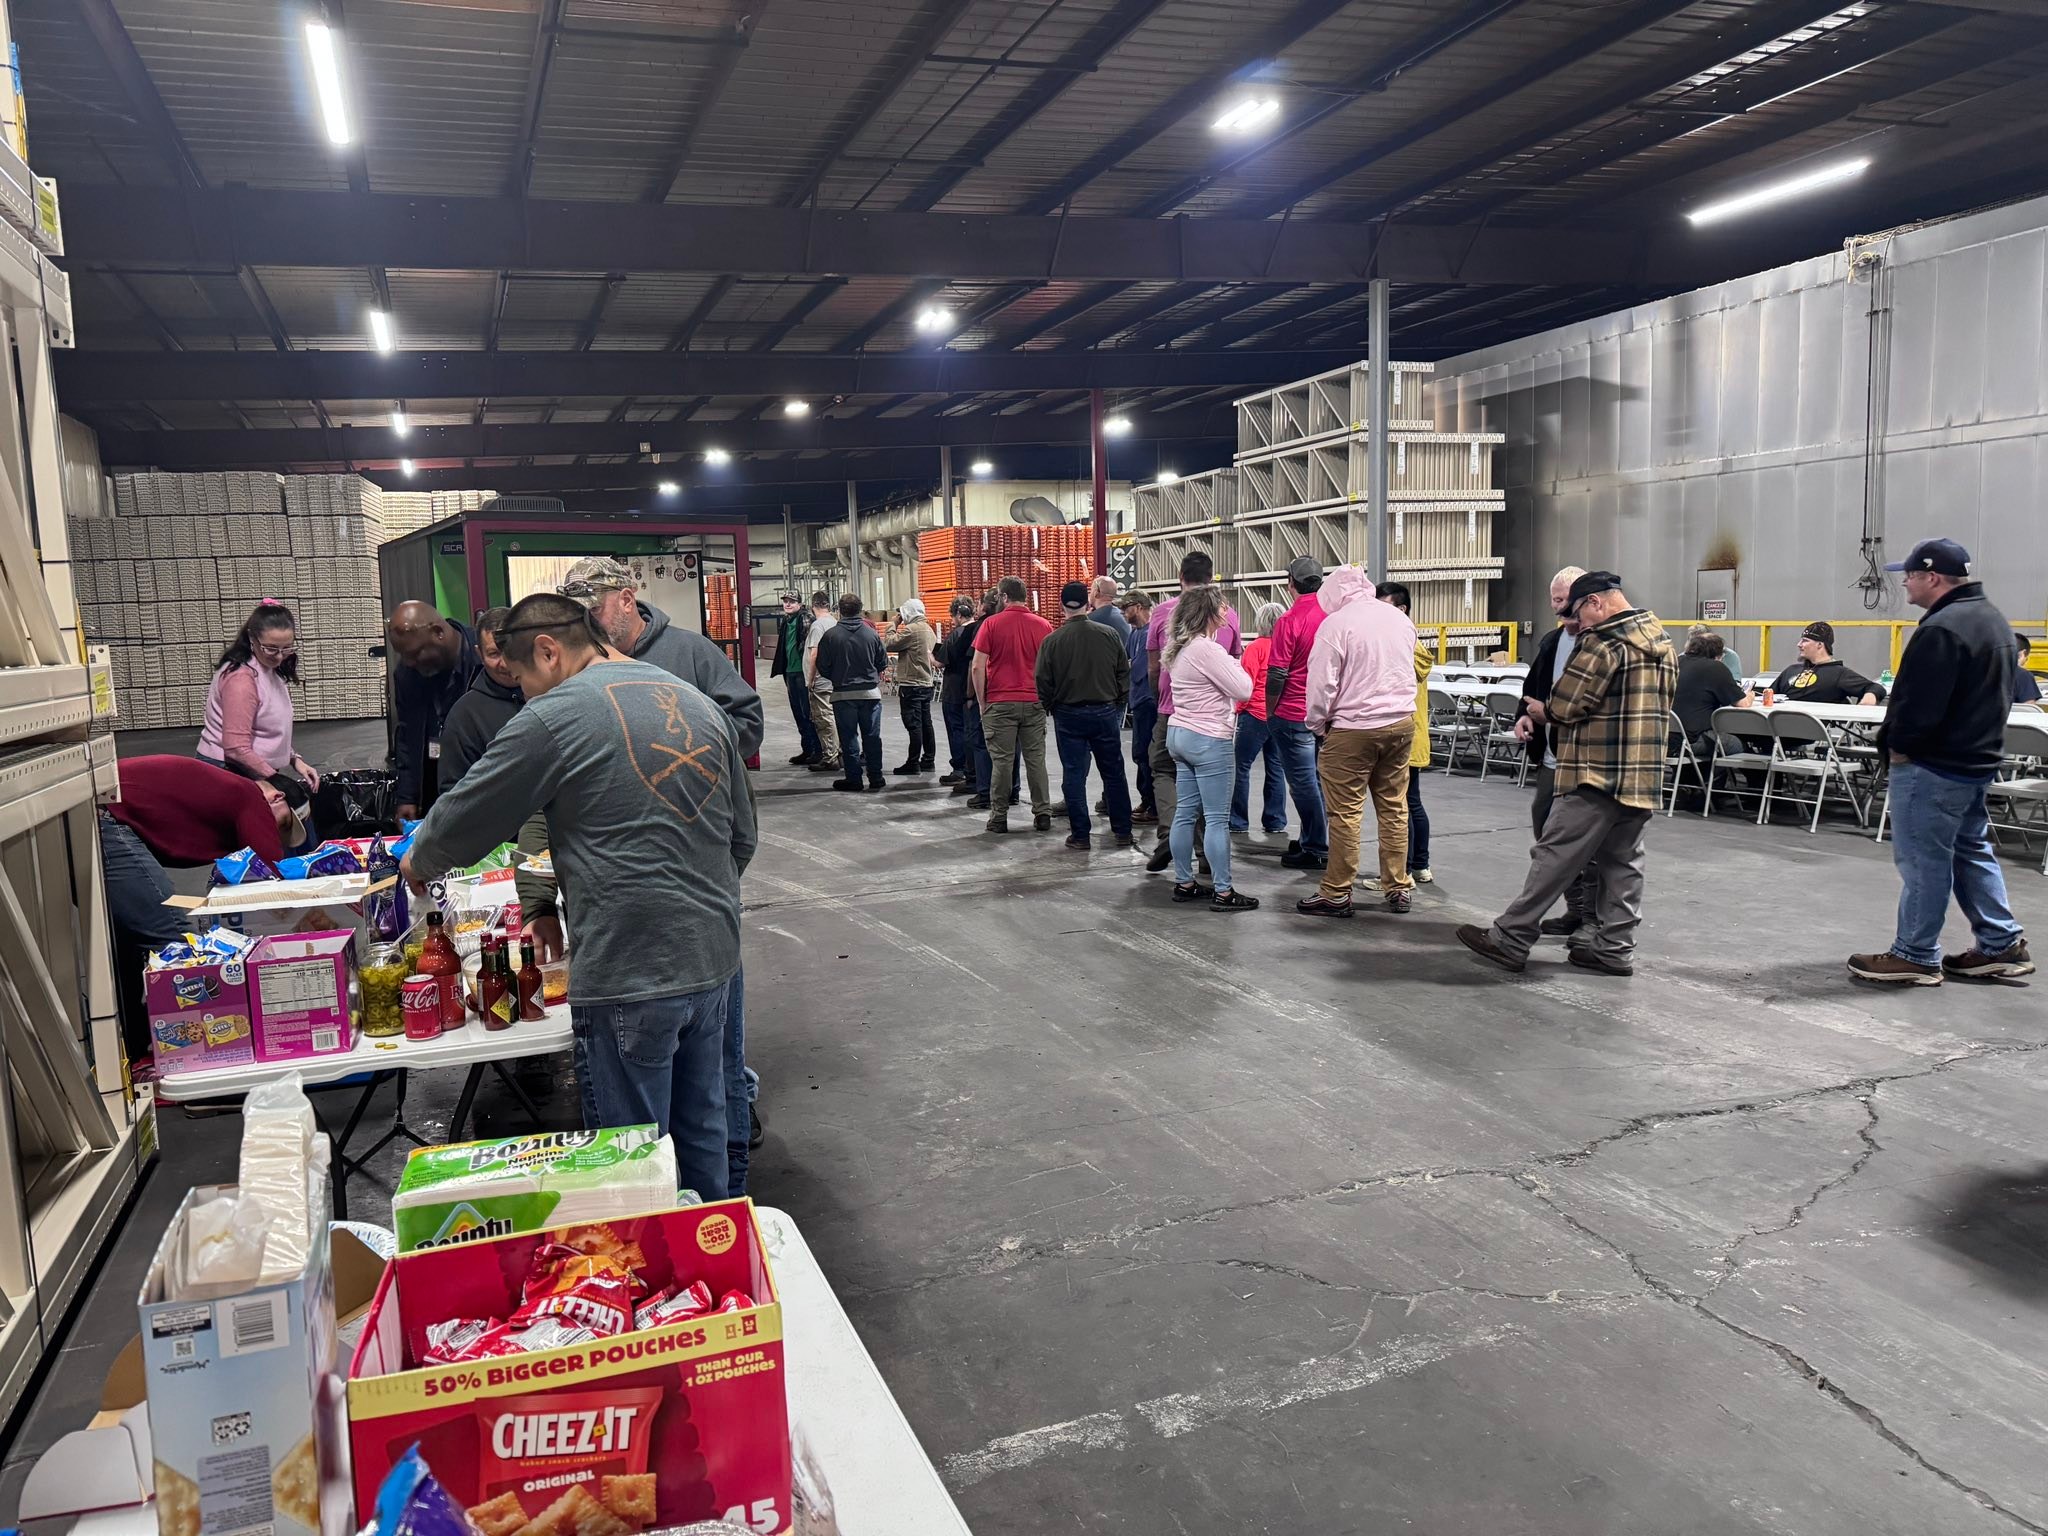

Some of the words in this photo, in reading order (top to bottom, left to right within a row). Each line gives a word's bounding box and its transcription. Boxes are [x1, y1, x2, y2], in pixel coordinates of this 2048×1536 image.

[443, 544, 466, 552] SCA
[226, 964, 241, 973] 60
[508, 1149, 565, 1166] Napkins
[701, 1224, 730, 1238] REAL
[703, 1232, 731, 1244] 100%
[424, 1372, 482, 1397] 50%
[487, 1354, 584, 1386] BIGGER
[590, 1328, 707, 1368] POUCHES
[695, 1357, 731, 1374] THAN
[735, 1351, 764, 1365] OUR
[686, 1377, 693, 1387] 1
[695, 1373, 713, 1385] OZ
[715, 1359, 776, 1382] POUCHES
[523, 1469, 595, 1492] ORIGINAL
[721, 1497, 780, 1535] 45
